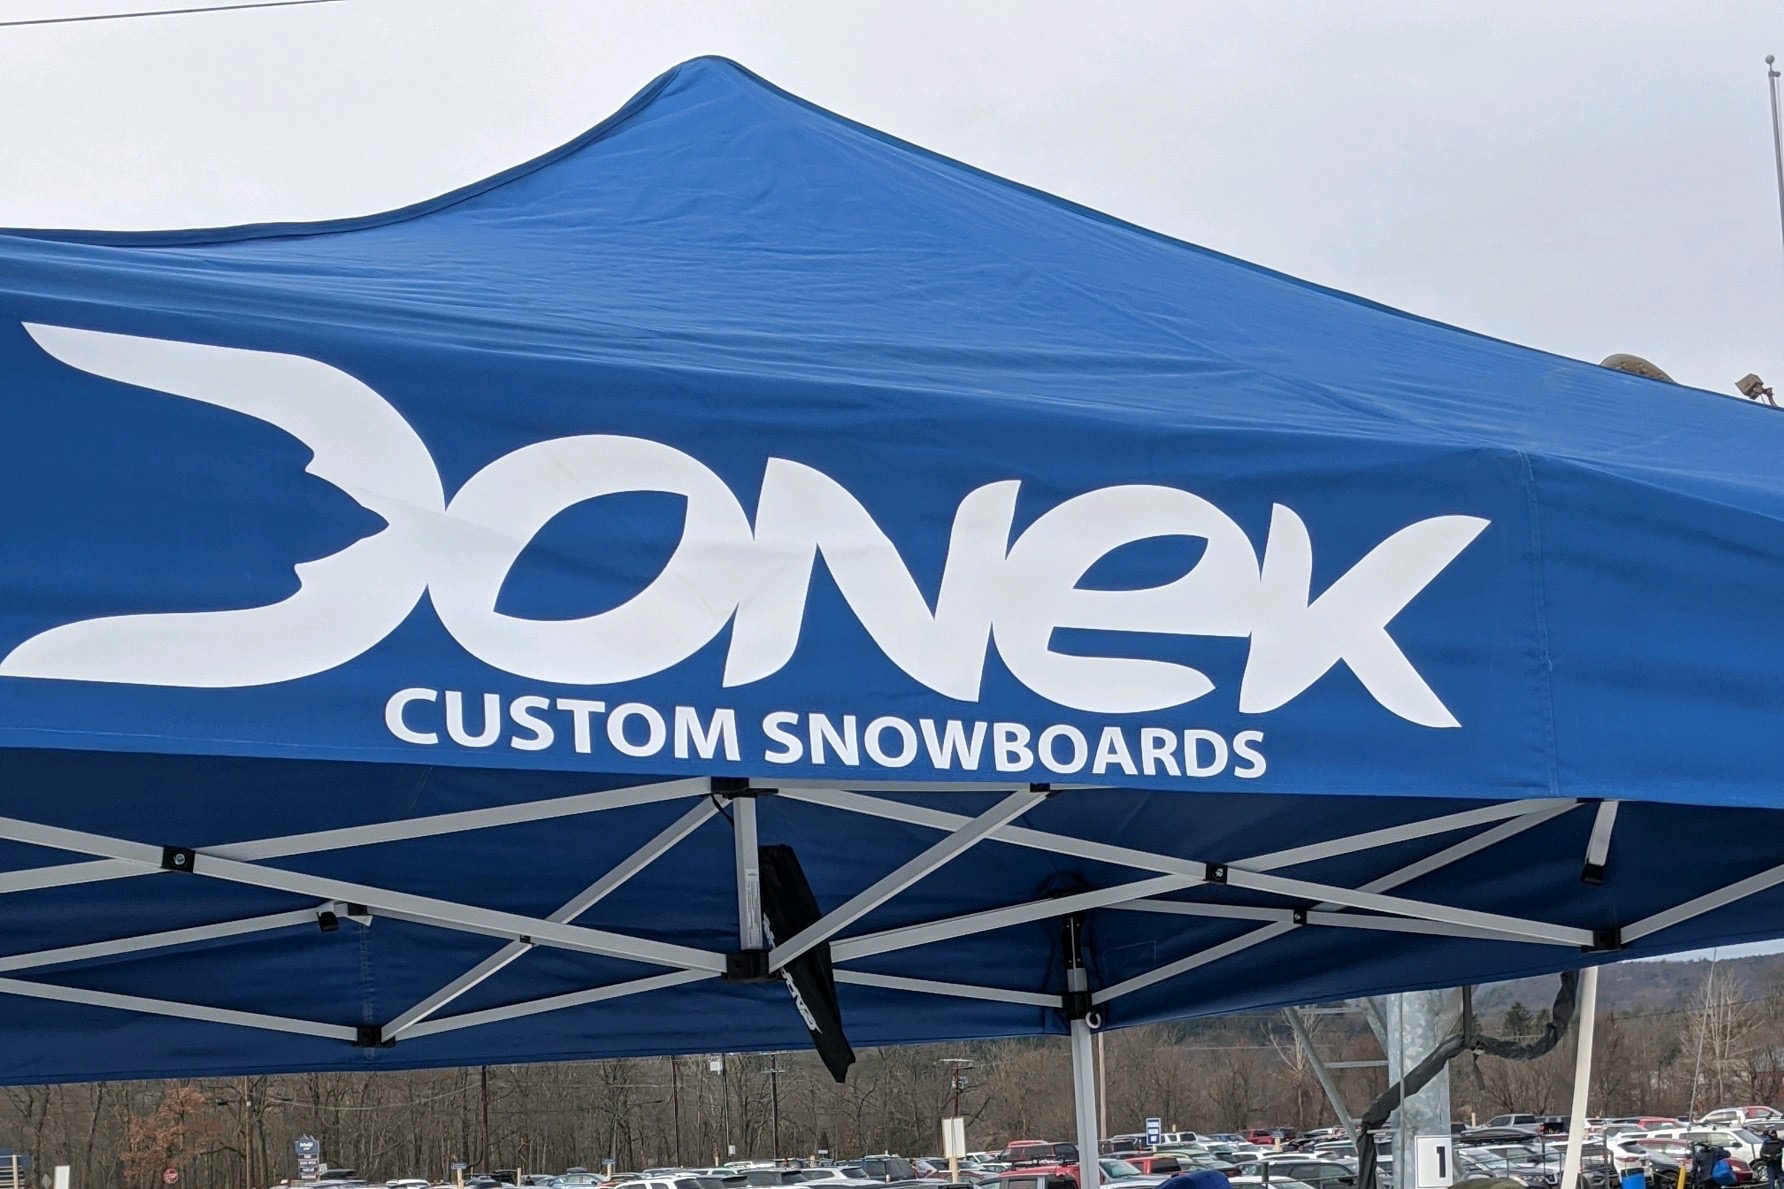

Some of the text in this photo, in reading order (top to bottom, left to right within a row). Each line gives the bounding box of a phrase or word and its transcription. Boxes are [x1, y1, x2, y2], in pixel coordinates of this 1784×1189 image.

[385, 688, 1267, 779] CUSTOM SNOWBOARDS
[1436, 1146, 1446, 1178] 1
